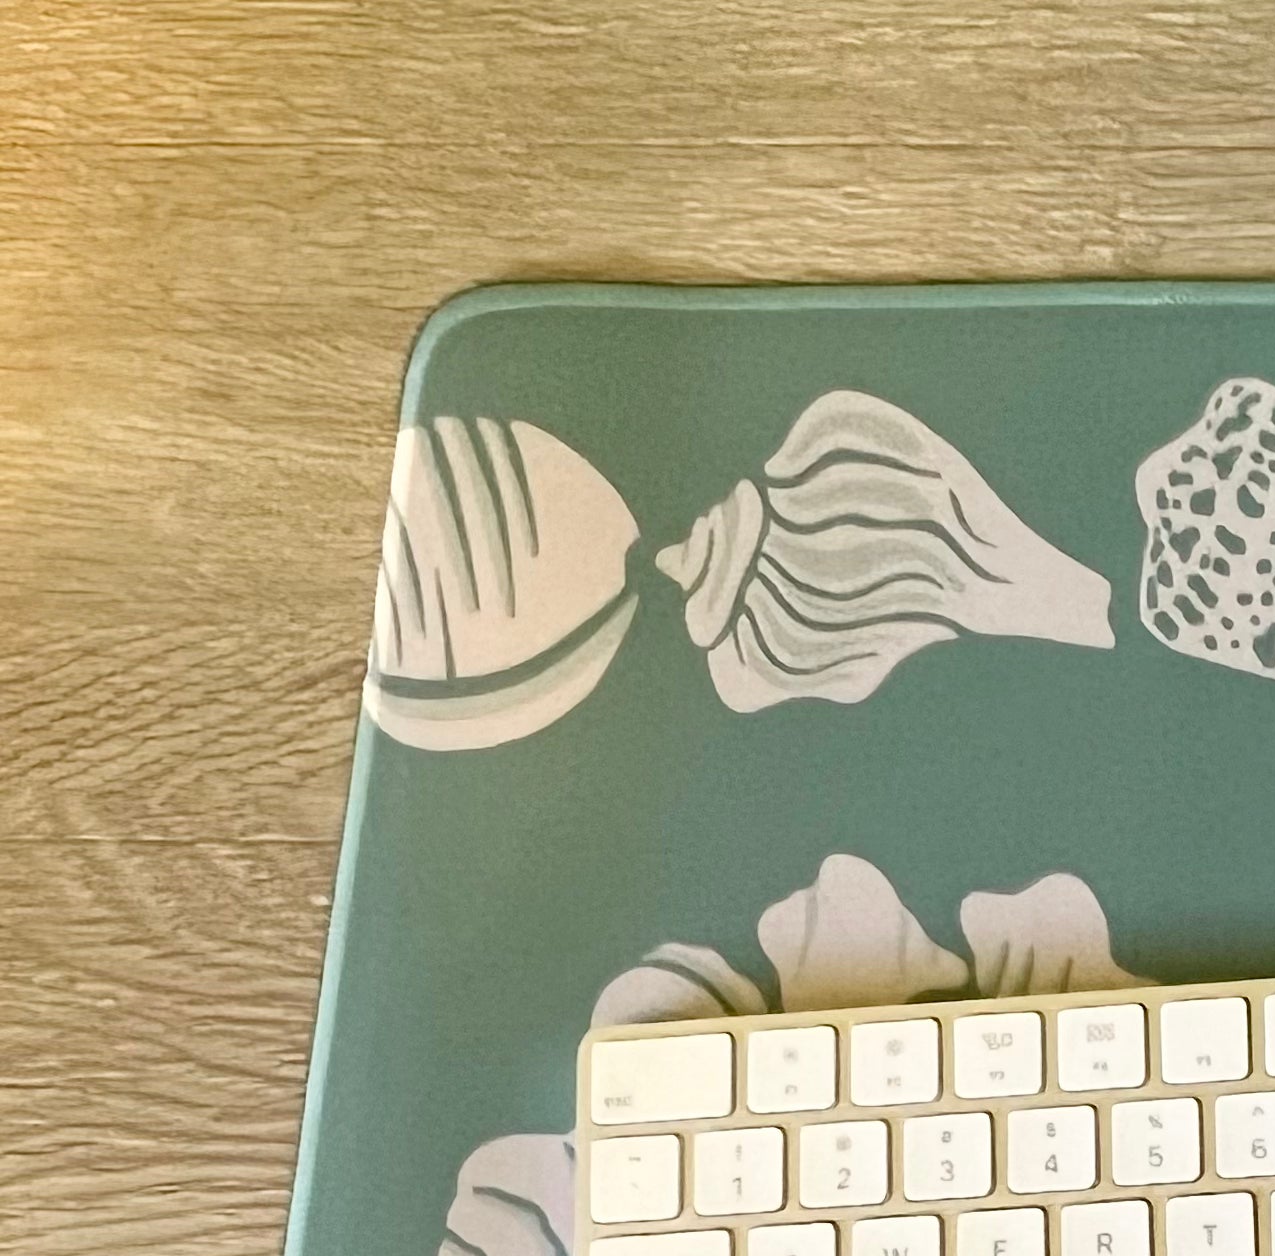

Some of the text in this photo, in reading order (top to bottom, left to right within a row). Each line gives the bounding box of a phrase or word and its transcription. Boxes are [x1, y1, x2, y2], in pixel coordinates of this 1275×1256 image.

[1148, 1145, 1164, 1168] 5
[1250, 1138, 1268, 1160] 6
[939, 1159, 956, 1182] 3
[1044, 1153, 1059, 1174] 4
[836, 1167, 852, 1191] 2
[1096, 1232, 1113, 1255] R
[1202, 1224, 1218, 1247] T
